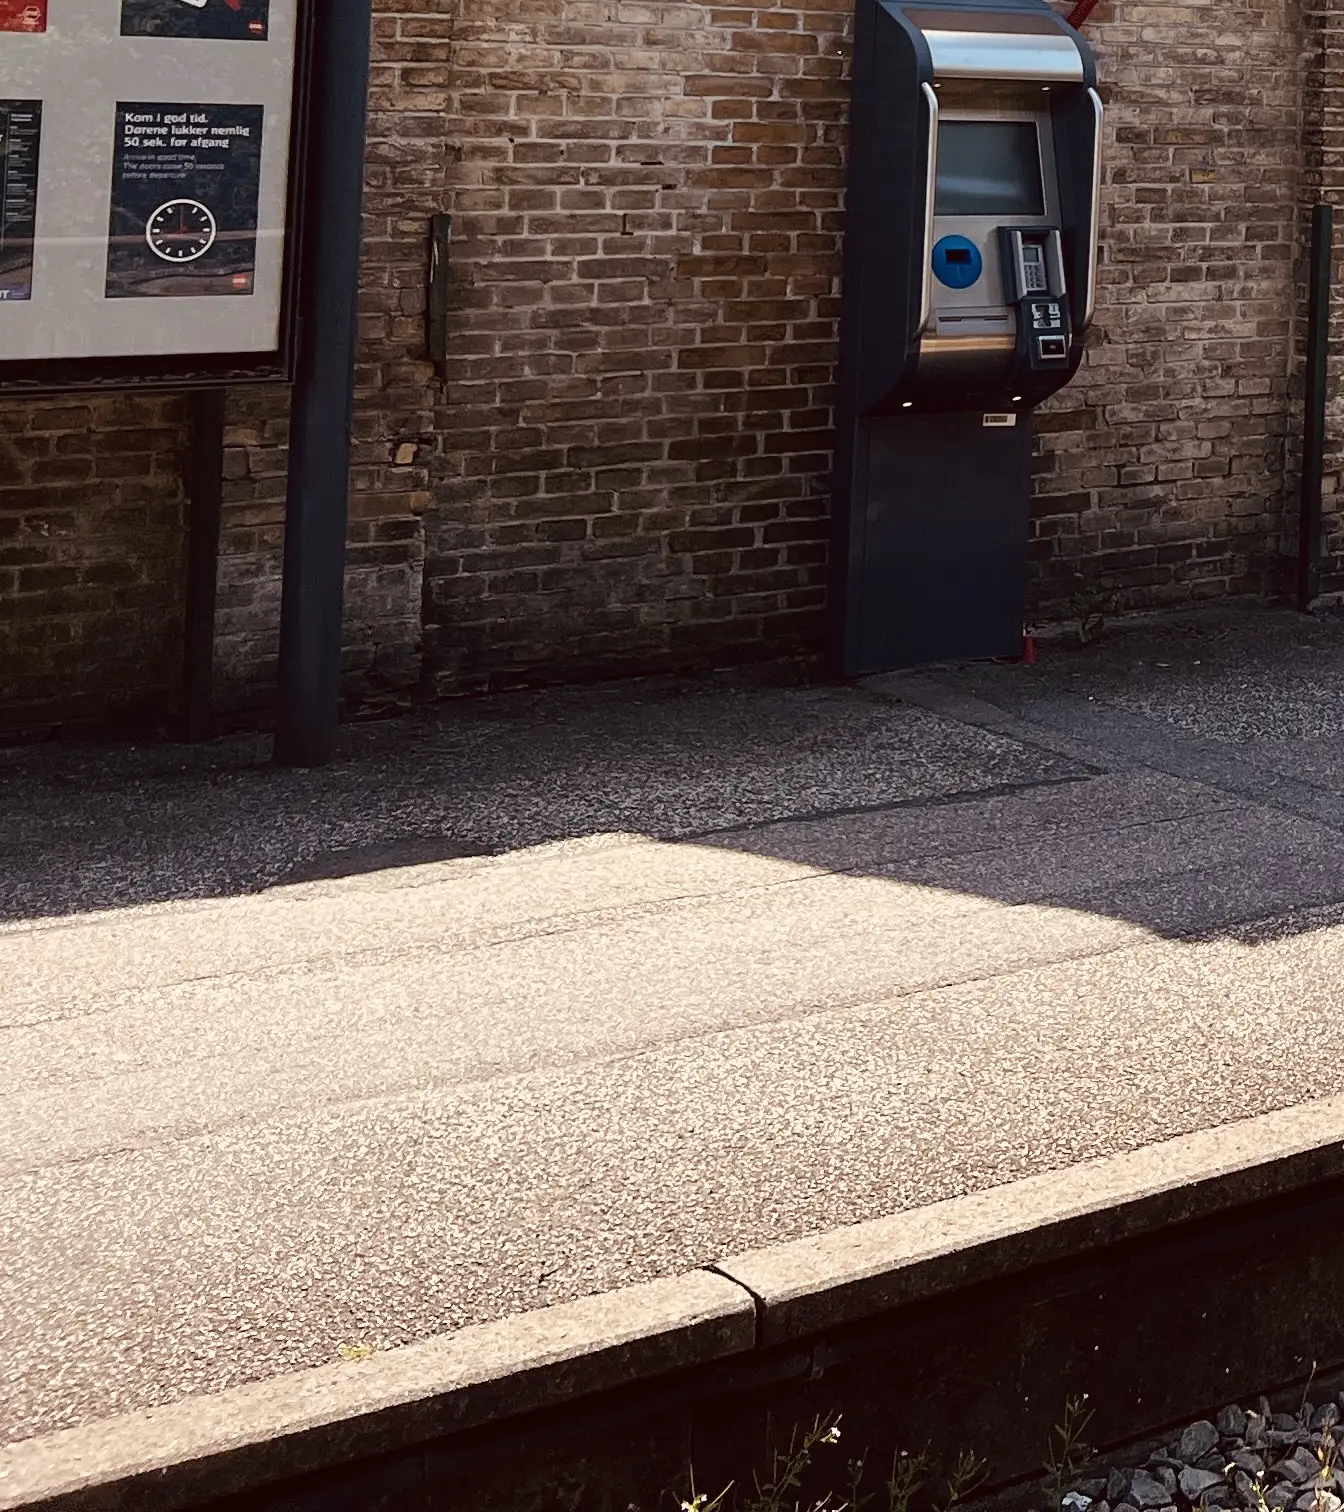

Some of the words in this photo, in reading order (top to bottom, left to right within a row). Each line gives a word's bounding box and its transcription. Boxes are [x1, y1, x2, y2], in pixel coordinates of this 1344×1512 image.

[125, 113, 153, 123] Kom
[156, 113, 161, 123] i
[164, 113, 186, 124] god
[190, 113, 208, 123] tid.
[124, 125, 168, 135] Dørene
[171, 125, 208, 135] lukker
[211, 125, 250, 136] nemlig
[124, 137, 140, 147] 50
[143, 137, 167, 147] sek.
[170, 137, 187, 147] før
[190, 137, 229, 148] afgang
